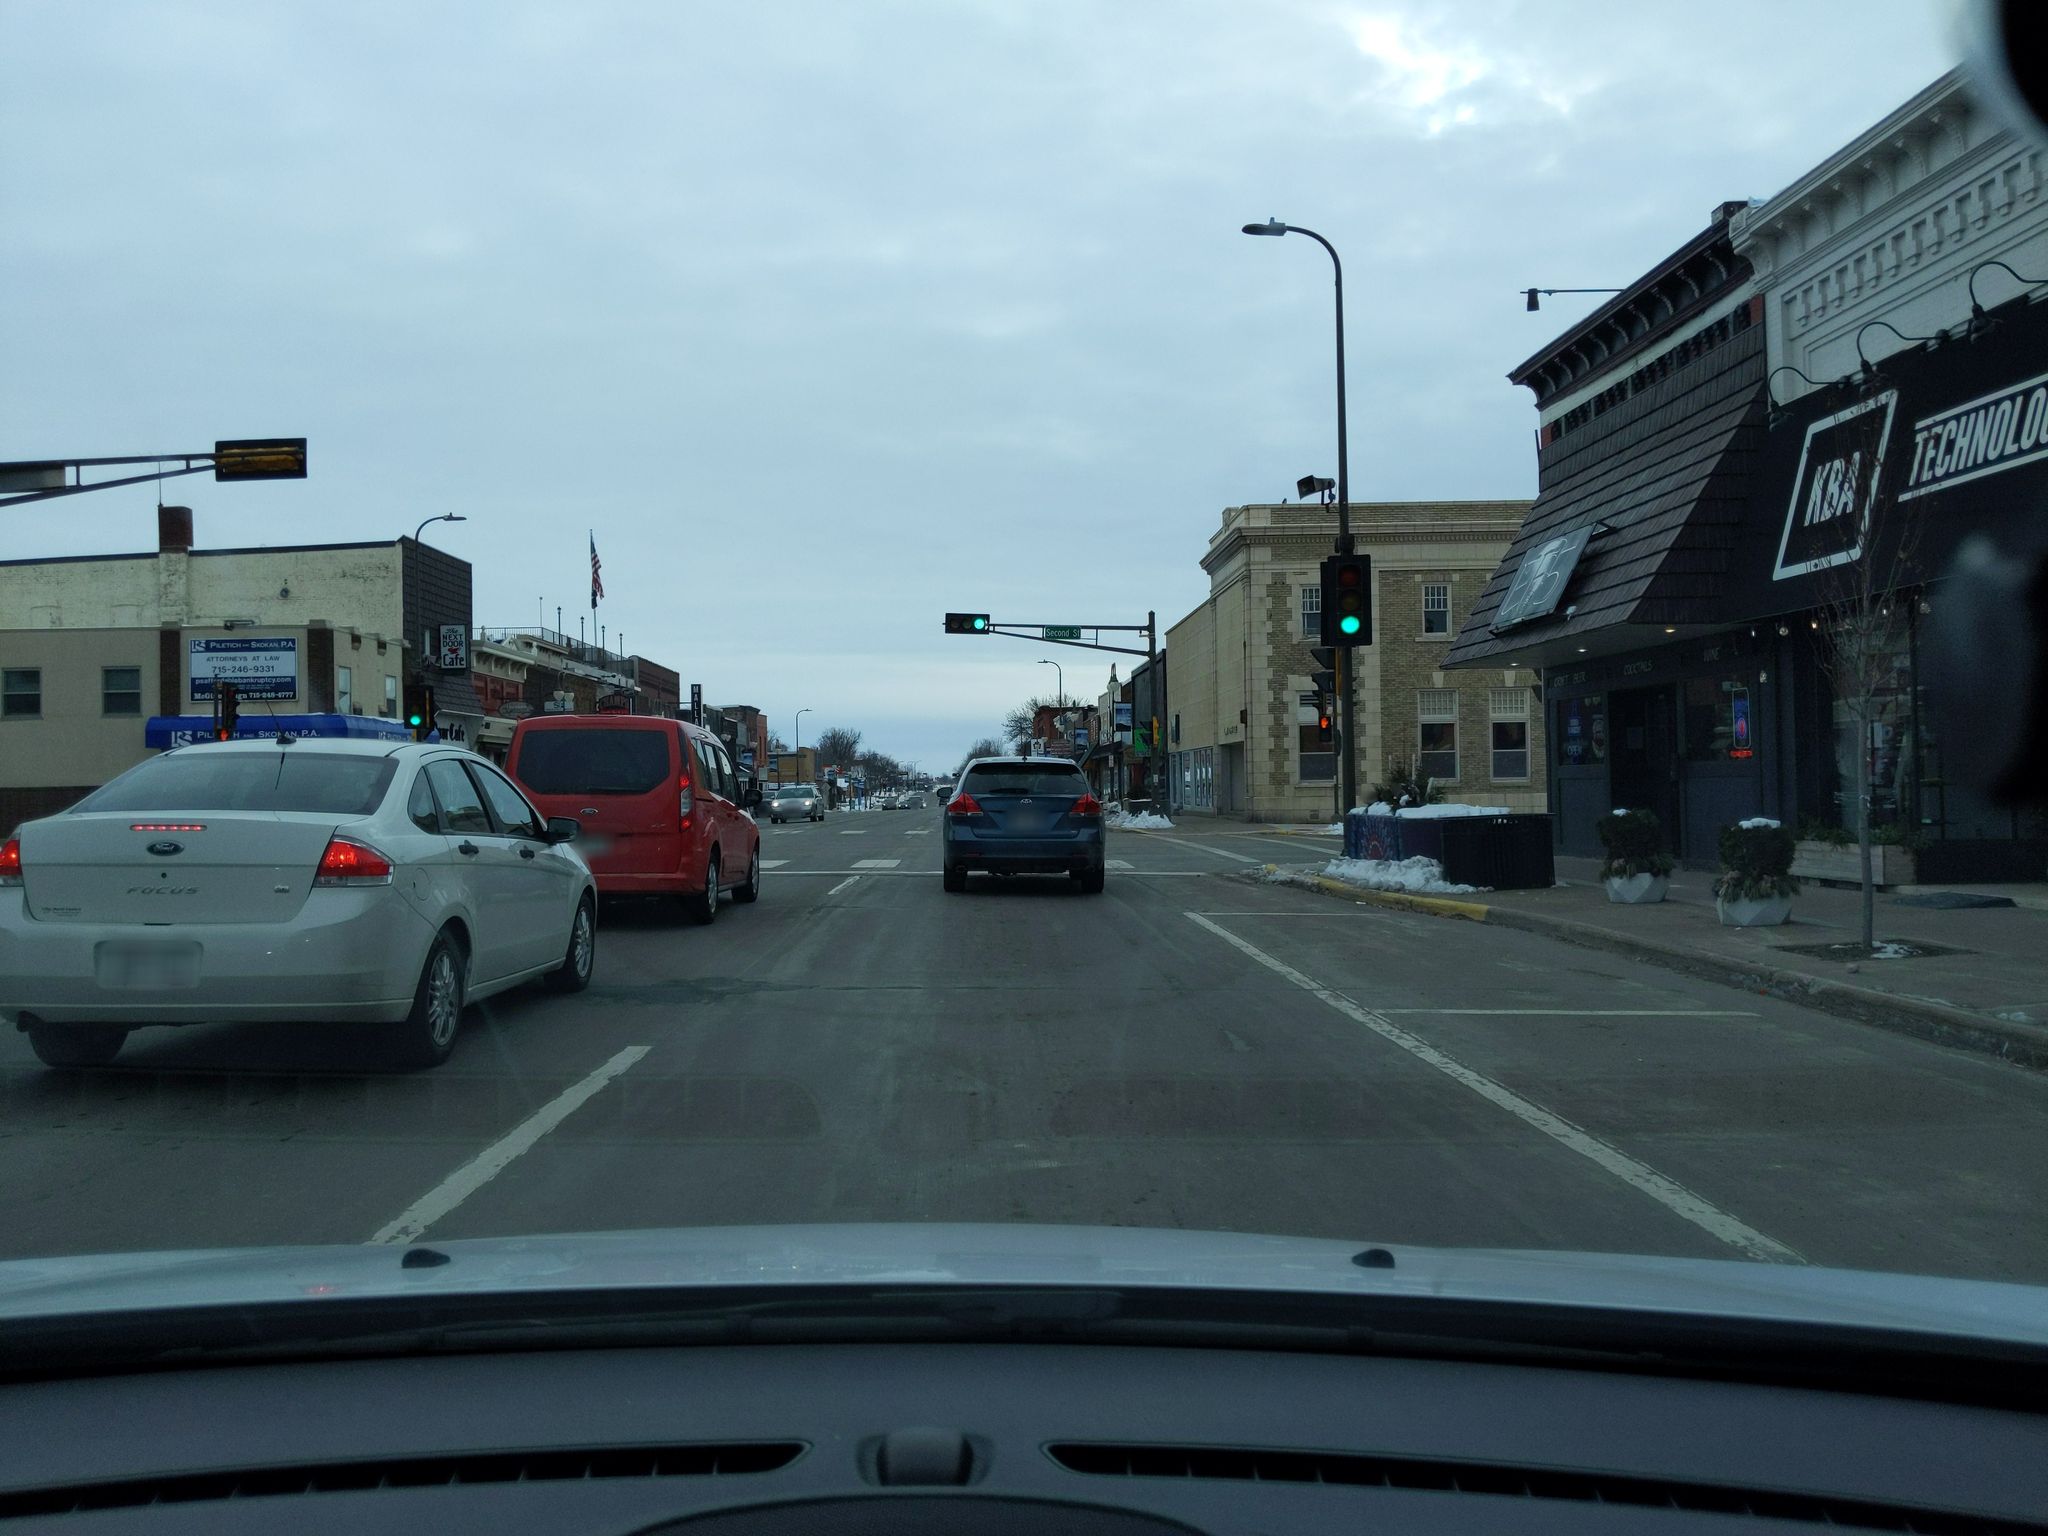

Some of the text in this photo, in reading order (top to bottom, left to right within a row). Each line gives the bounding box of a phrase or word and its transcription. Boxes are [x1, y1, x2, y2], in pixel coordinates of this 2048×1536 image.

[1803, 451, 1861, 528] KBA
[442, 633, 463, 641] NEXT
[1046, 628, 1080, 637] Second St
[442, 640, 464, 648] DOOR
[442, 653, 465, 667] Cafe
[211, 665, 276, 674] 715-246-9331
[197, 730, 240, 739] PILH
[301, 729, 320, 738] P.A.
[126, 886, 201, 895] FOCUS
